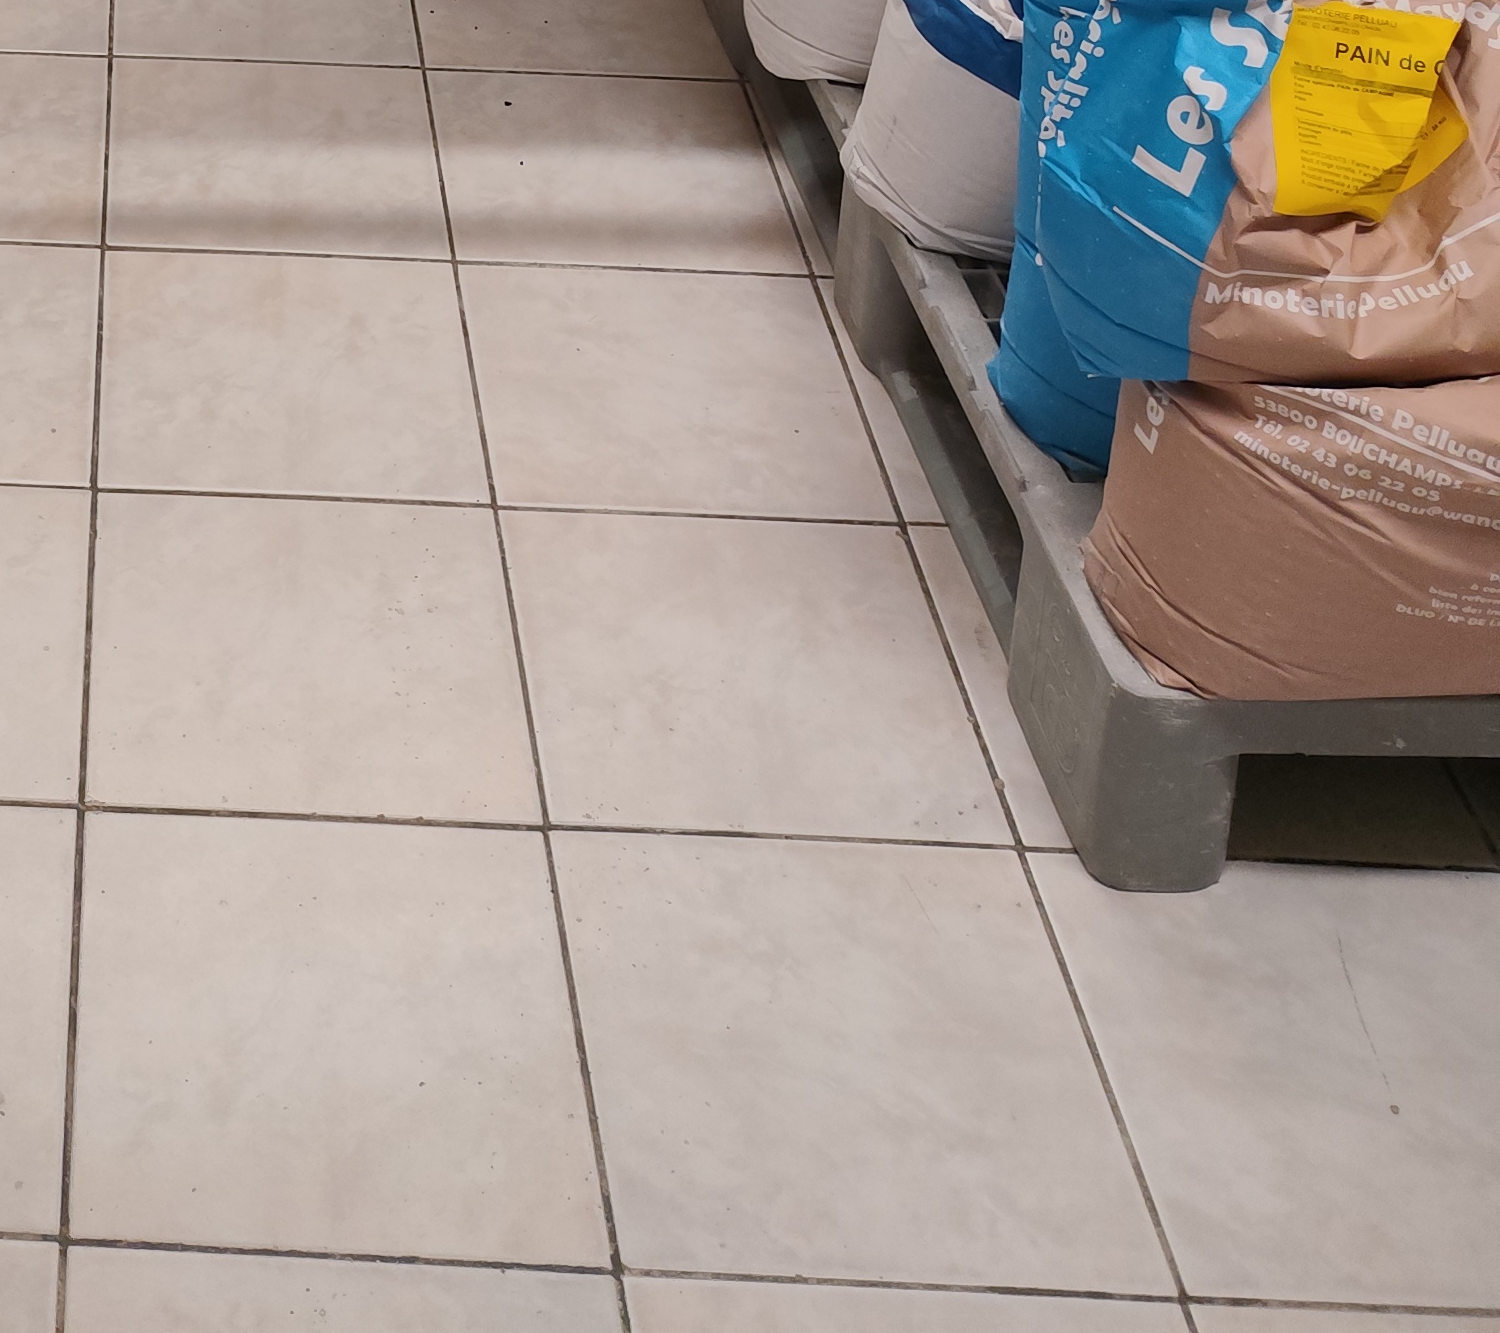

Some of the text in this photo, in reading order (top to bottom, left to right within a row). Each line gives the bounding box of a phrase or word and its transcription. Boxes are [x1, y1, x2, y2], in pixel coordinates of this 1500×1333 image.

[1352, 13, 1398, 29] PELLUAU
[1335, 41, 1391, 67] PAIN
[1399, 53, 1426, 73] de
[1132, 65, 1228, 198] Les
[1203, 260, 1475, 321] Minoterie Pelluau
[1253, 395, 1319, 431] 53800
[1286, 434, 1312, 454] 02
[1311, 447, 1338, 469] 43
[1343, 462, 1373, 480] 06
[1377, 475, 1406, 493] 22
[1411, 486, 1441, 502] 05
